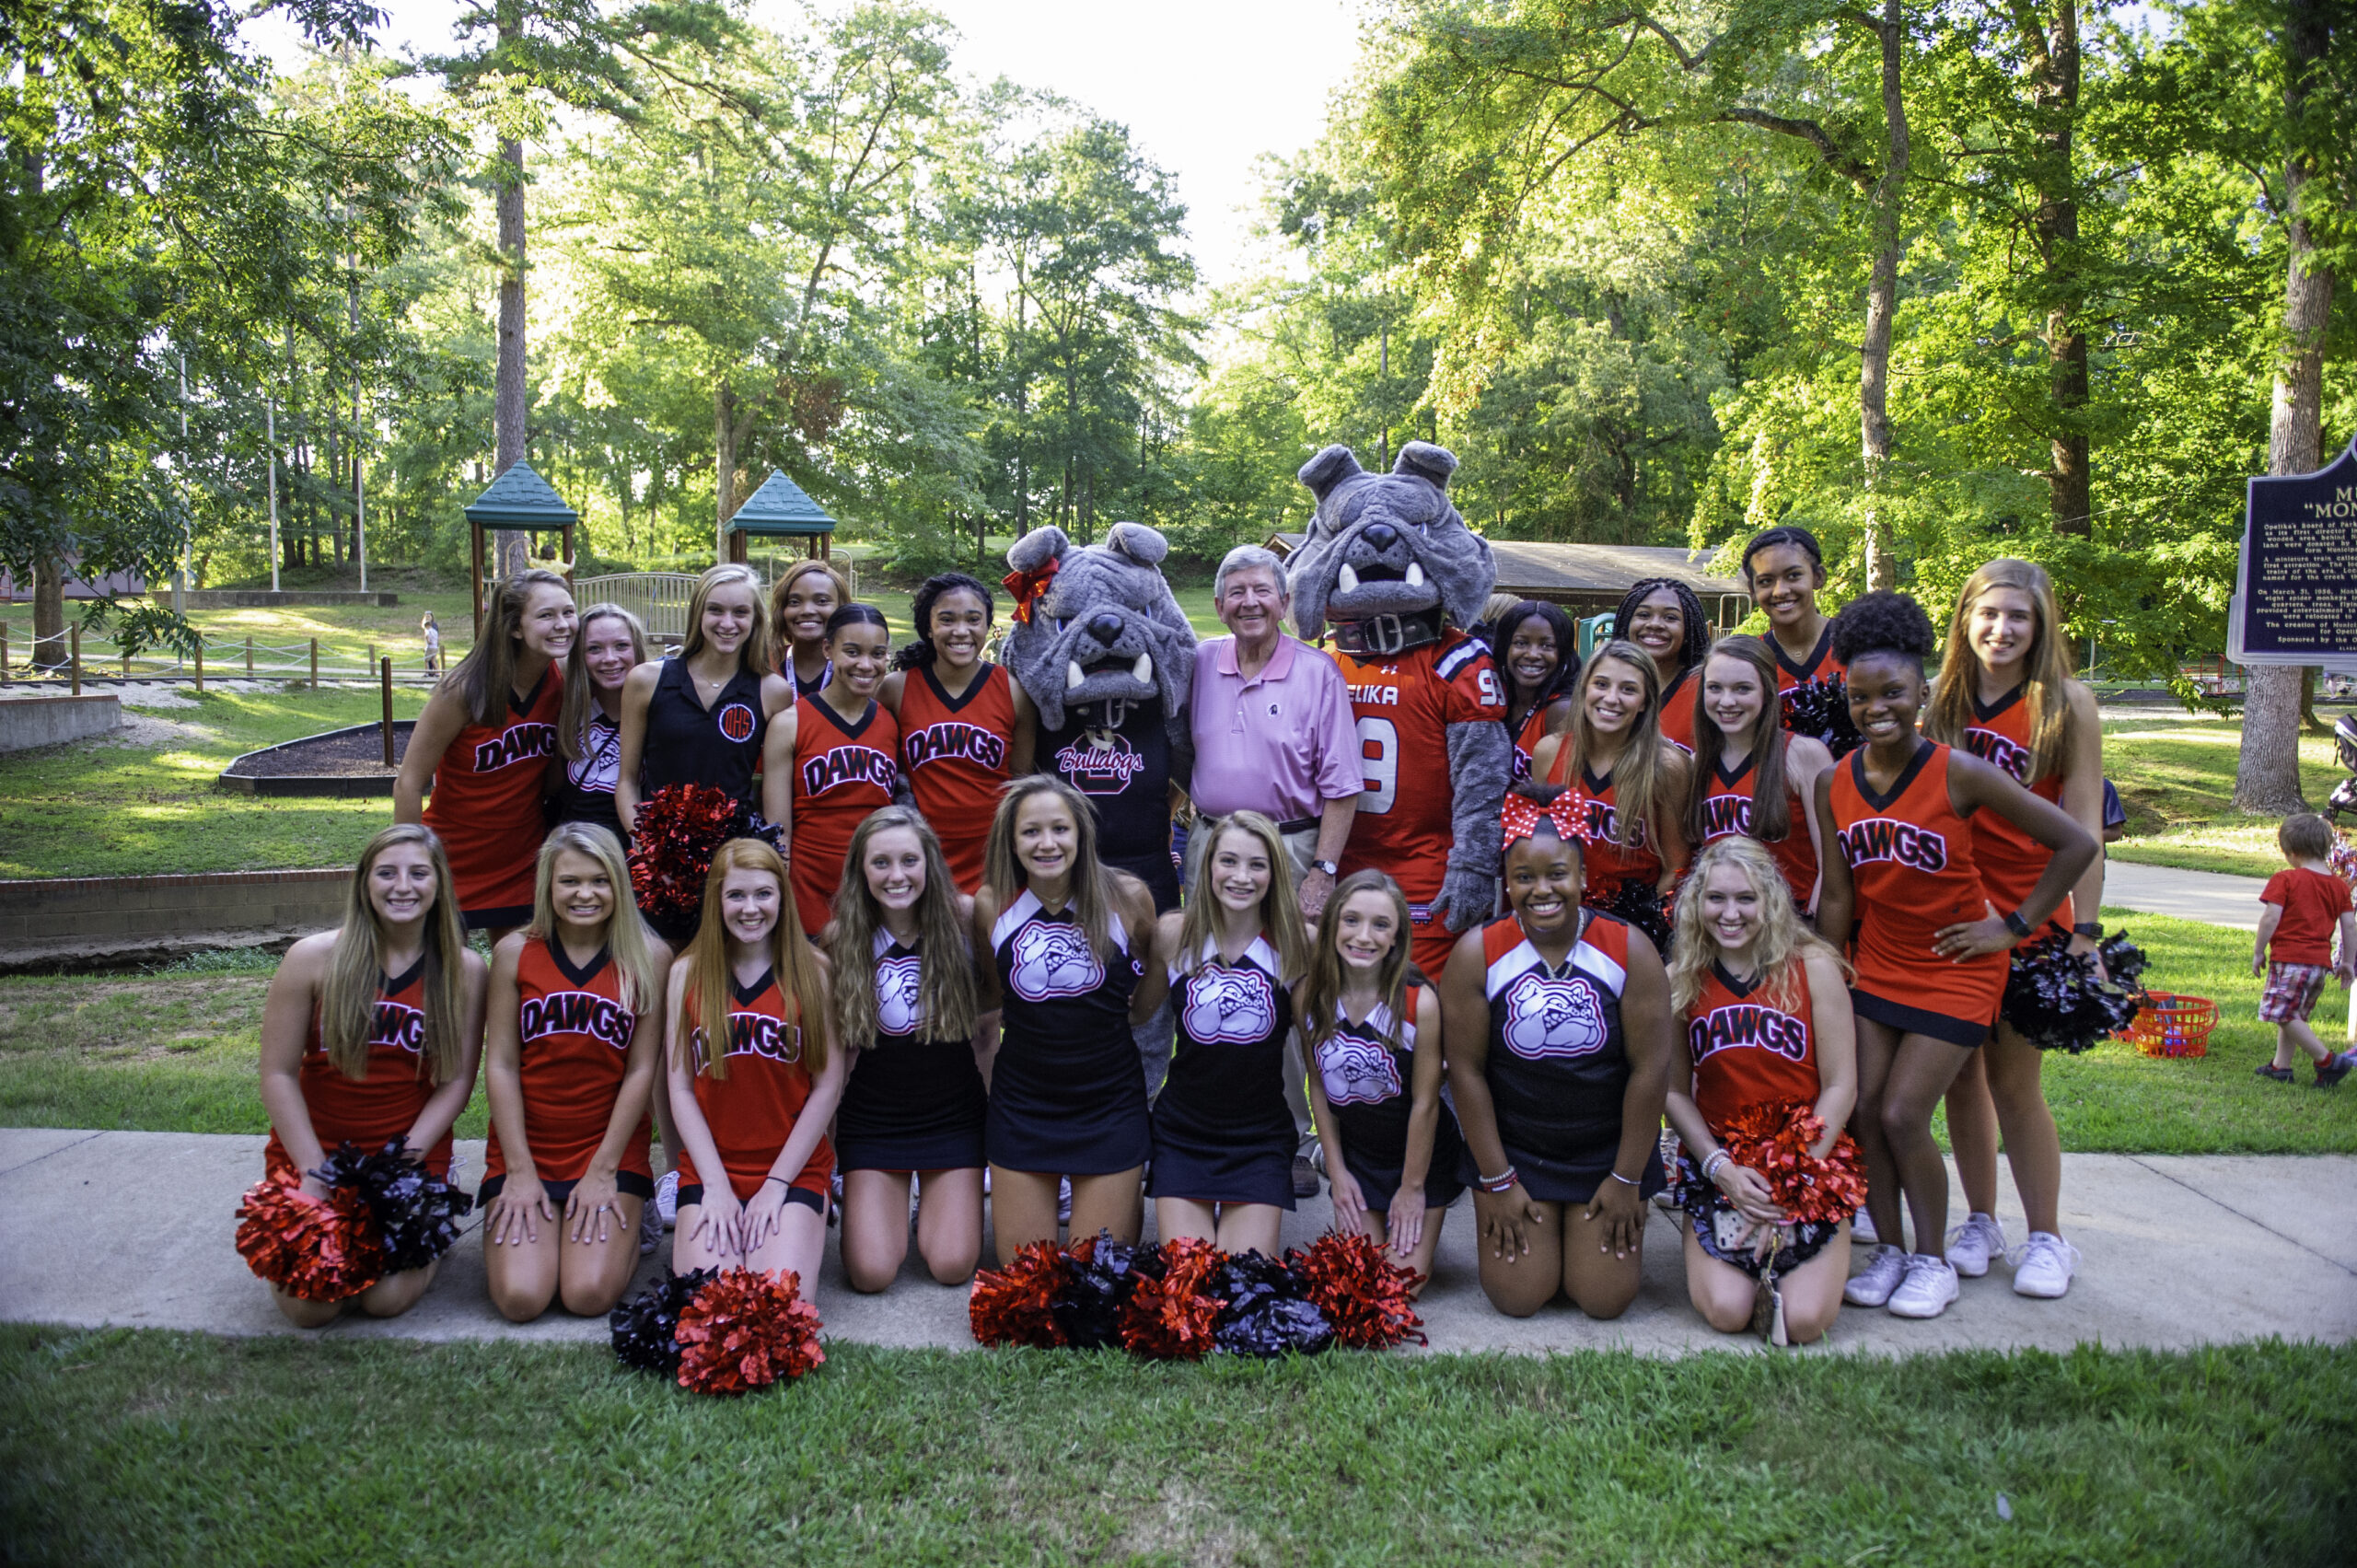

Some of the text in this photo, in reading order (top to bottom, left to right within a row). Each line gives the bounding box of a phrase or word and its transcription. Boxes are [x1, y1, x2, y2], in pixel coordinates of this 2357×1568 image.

[2336, 487, 2357, 502] M
[2264, 522, 2296, 530] Opelika's
[2277, 635, 2315, 644] Sponsored
[1347, 684, 1399, 706] ELIKA
[725, 708, 750, 738] OHS
[473, 722, 558, 773] DAWG
[906, 722, 1004, 771] DAWGS
[1054, 745, 1144, 780] Bulldogs
[804, 745, 897, 797] DAWGS
[521, 991, 635, 1050] DAWGS
[1689, 1004, 1806, 1066] DAWGS
[691, 1012, 801, 1076] DWGS
